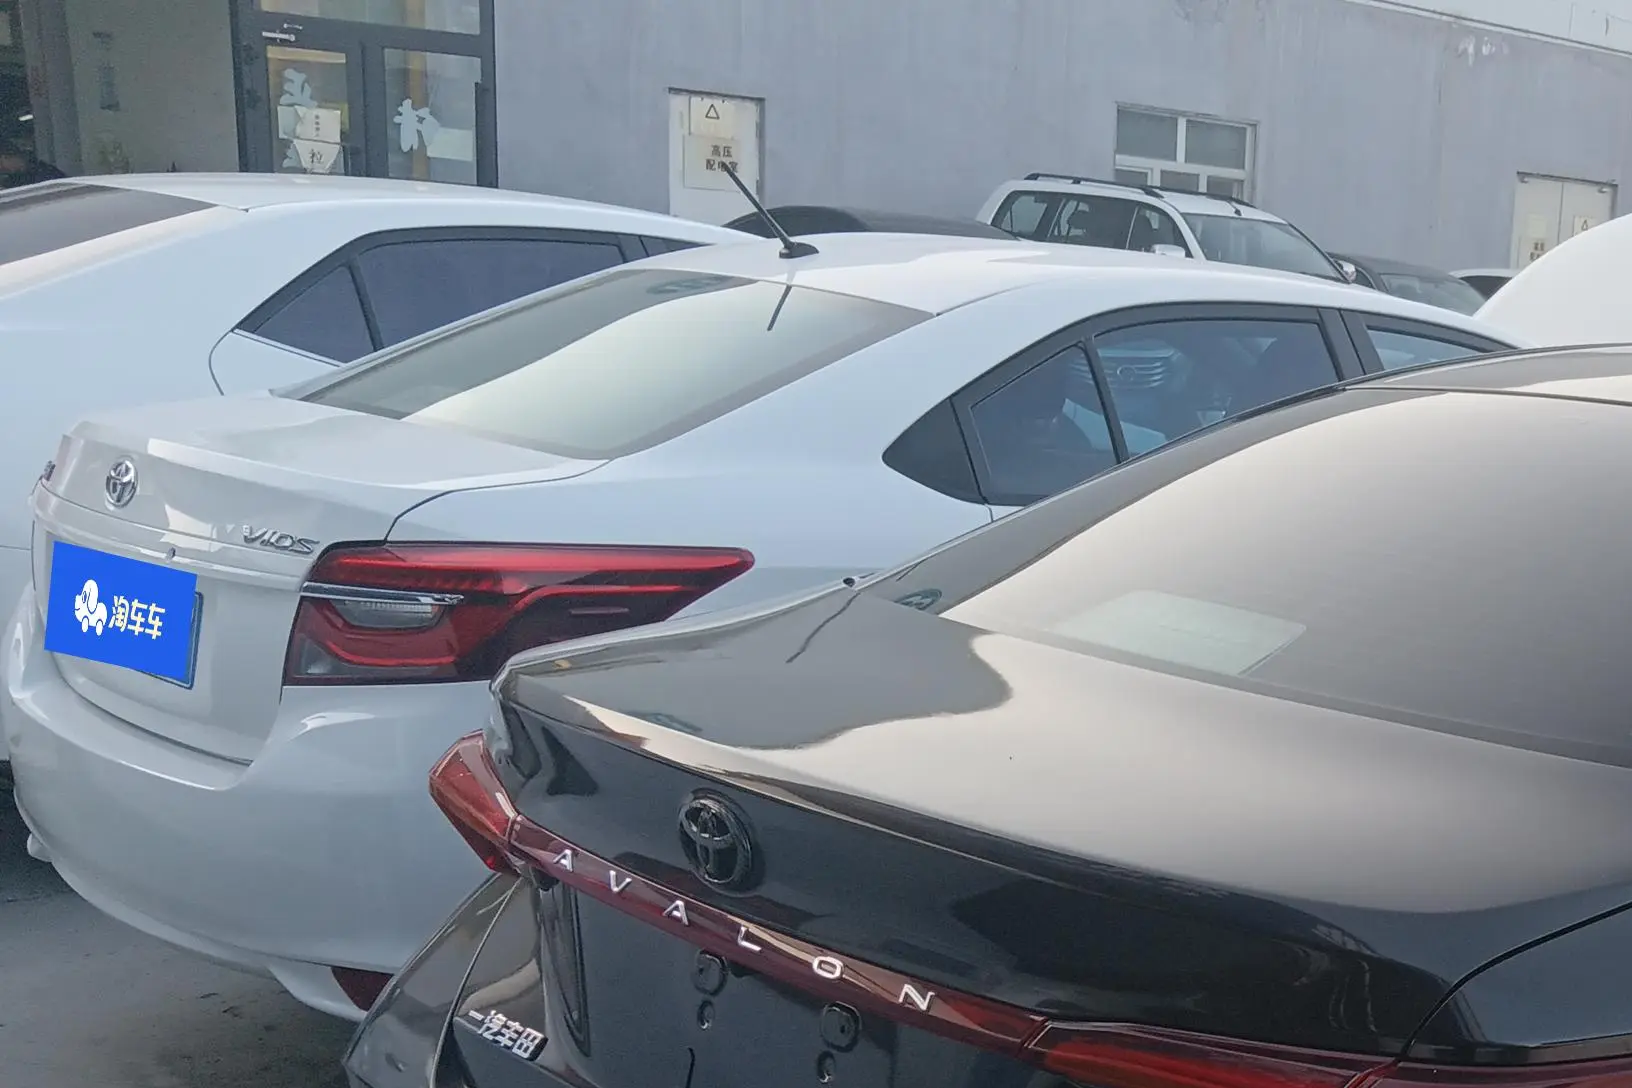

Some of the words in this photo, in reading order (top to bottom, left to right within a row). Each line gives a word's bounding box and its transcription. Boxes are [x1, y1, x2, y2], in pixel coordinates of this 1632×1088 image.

[242, 524, 321, 555] VIOS
[552, 848, 936, 1013] AVALON
[468, 1009, 546, 1059] 一汽丰田
